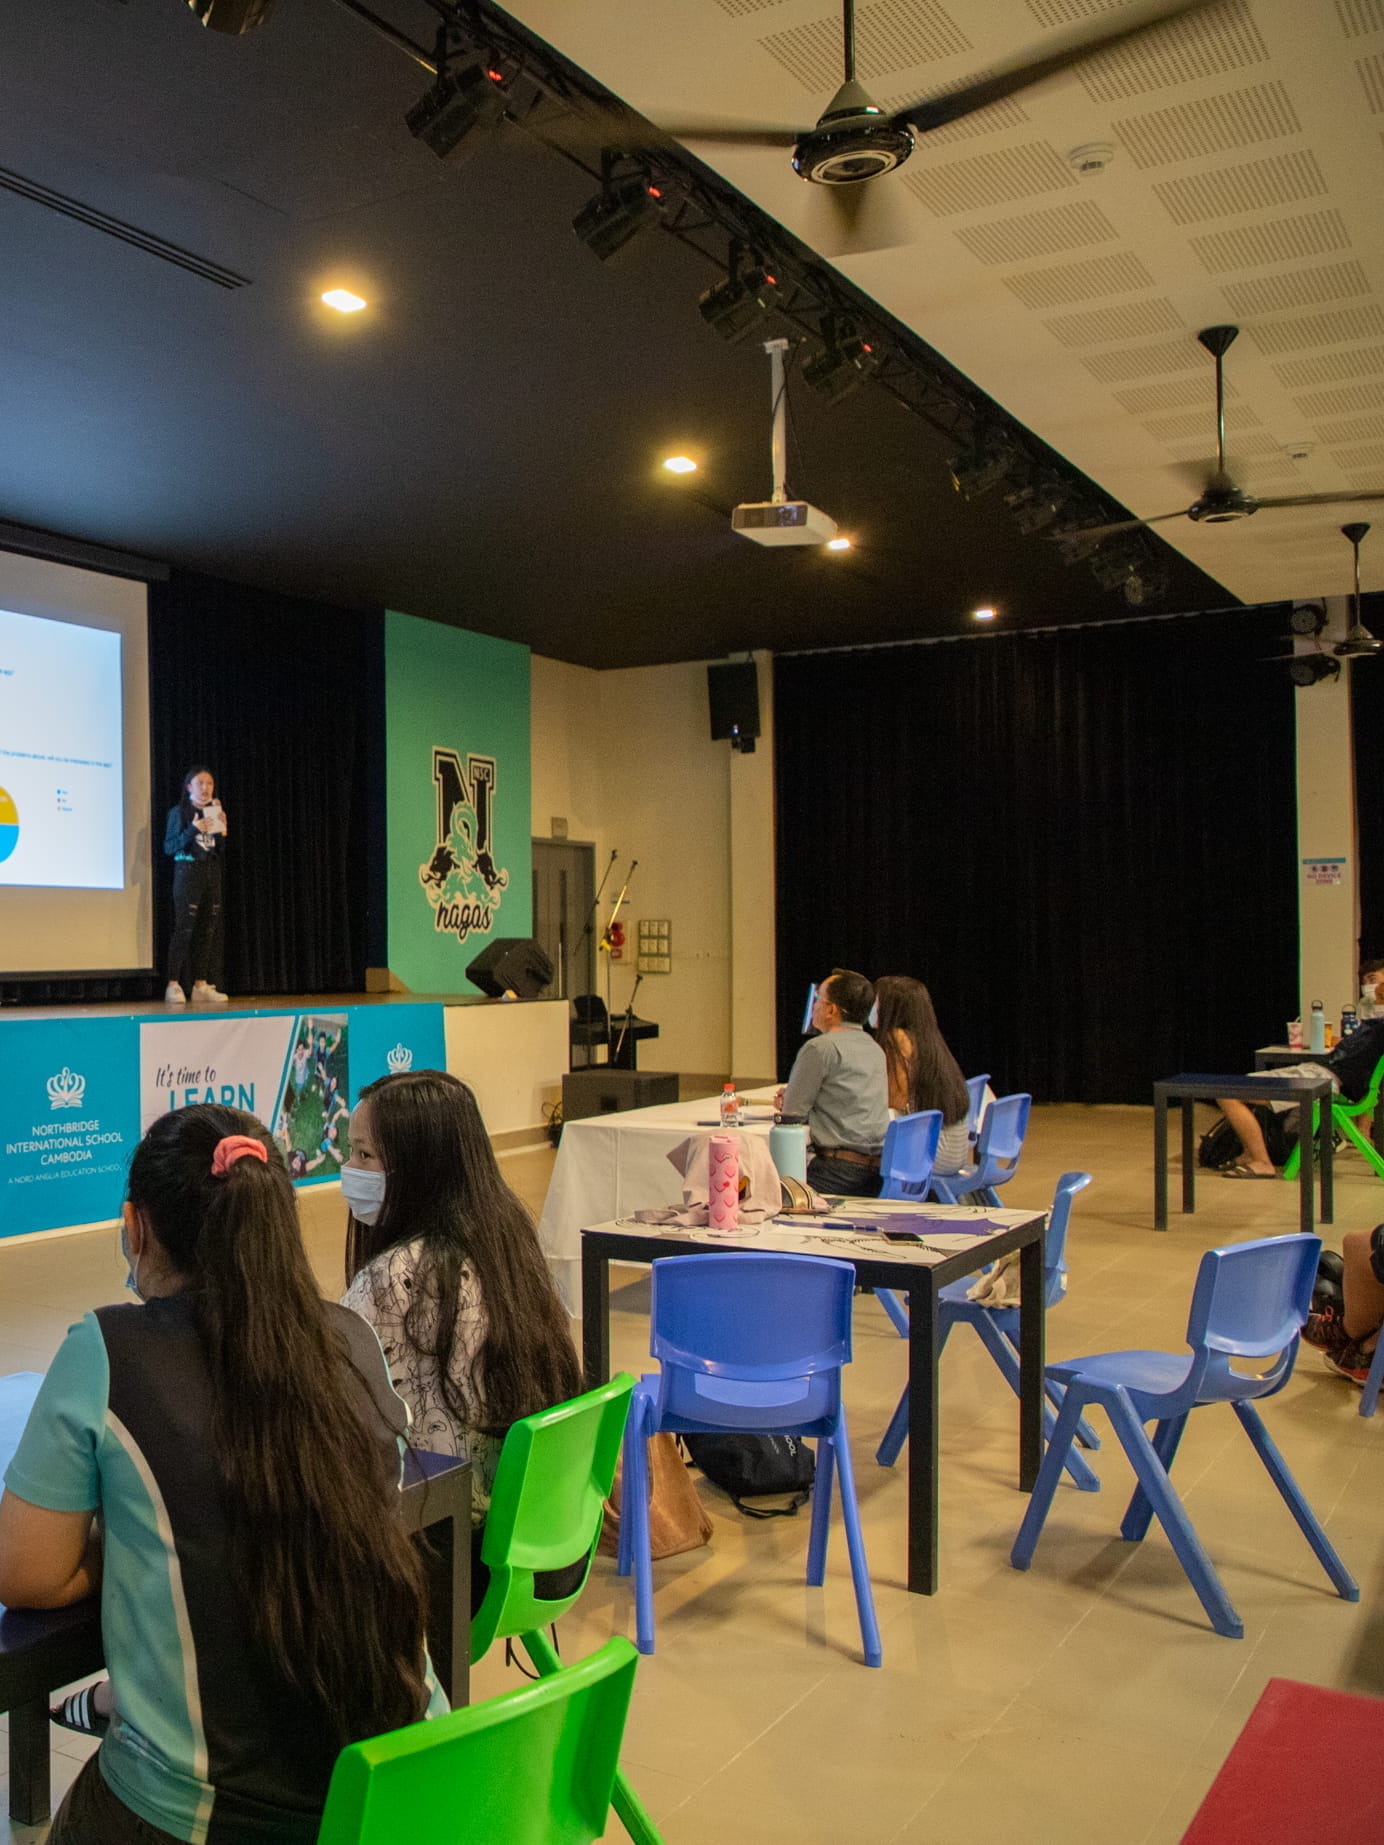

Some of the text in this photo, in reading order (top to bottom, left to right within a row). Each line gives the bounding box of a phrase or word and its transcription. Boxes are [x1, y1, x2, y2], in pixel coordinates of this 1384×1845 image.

[436, 901, 492, 940] nagas
[156, 1063, 217, 1088] It's time to
[31, 1120, 100, 1137] NORTHBRIDGE
[6, 1132, 124, 1155] INTERNATIONAL SCHOOL
[40, 1150, 93, 1166] CAMBODIA
[60, 1167, 97, 1179] EDUCATION
